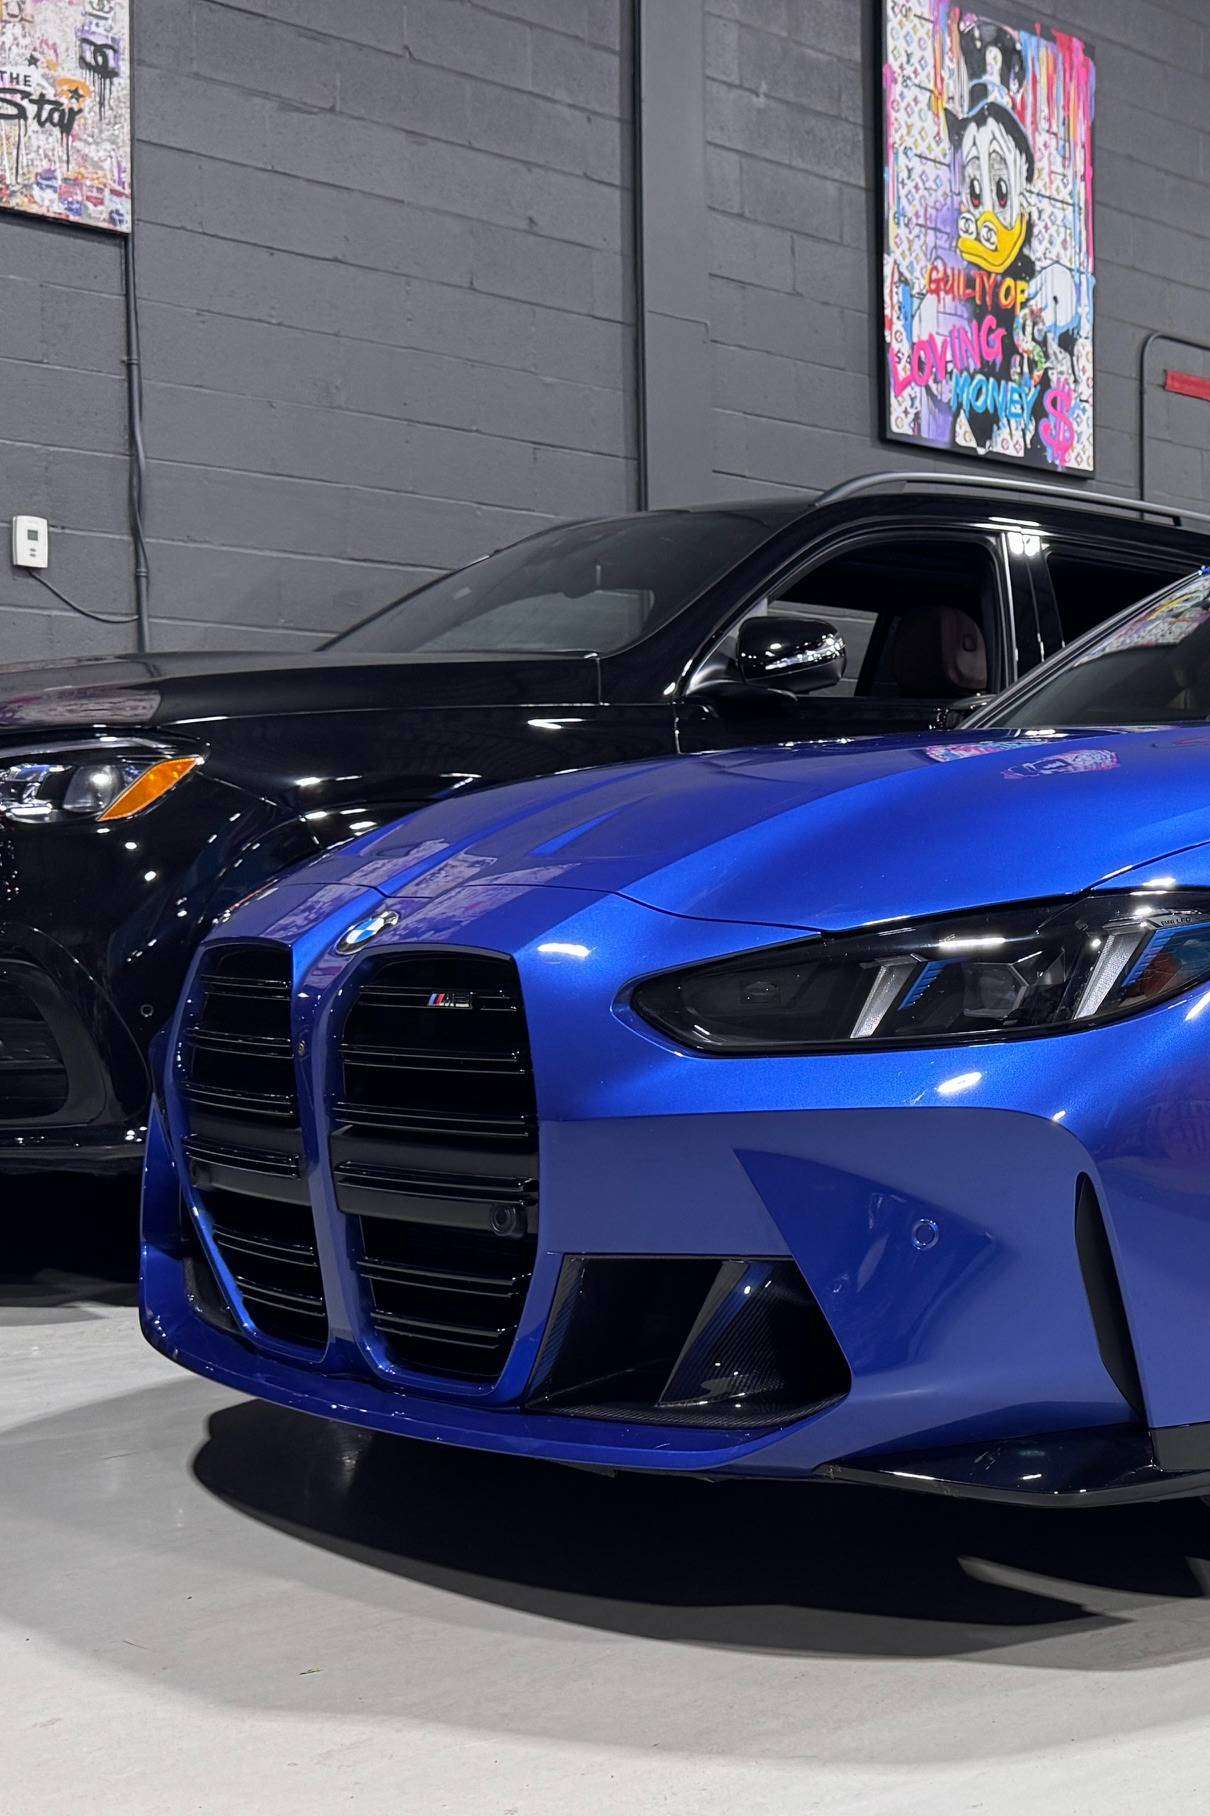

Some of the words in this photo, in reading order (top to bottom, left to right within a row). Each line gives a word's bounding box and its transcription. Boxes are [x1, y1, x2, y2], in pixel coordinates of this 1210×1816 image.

[927, 265, 997, 310] GUILTY
[1000, 278, 1029, 316] OF
[889, 315, 1006, 398] LOVING
[951, 371, 1040, 423] MONEY
